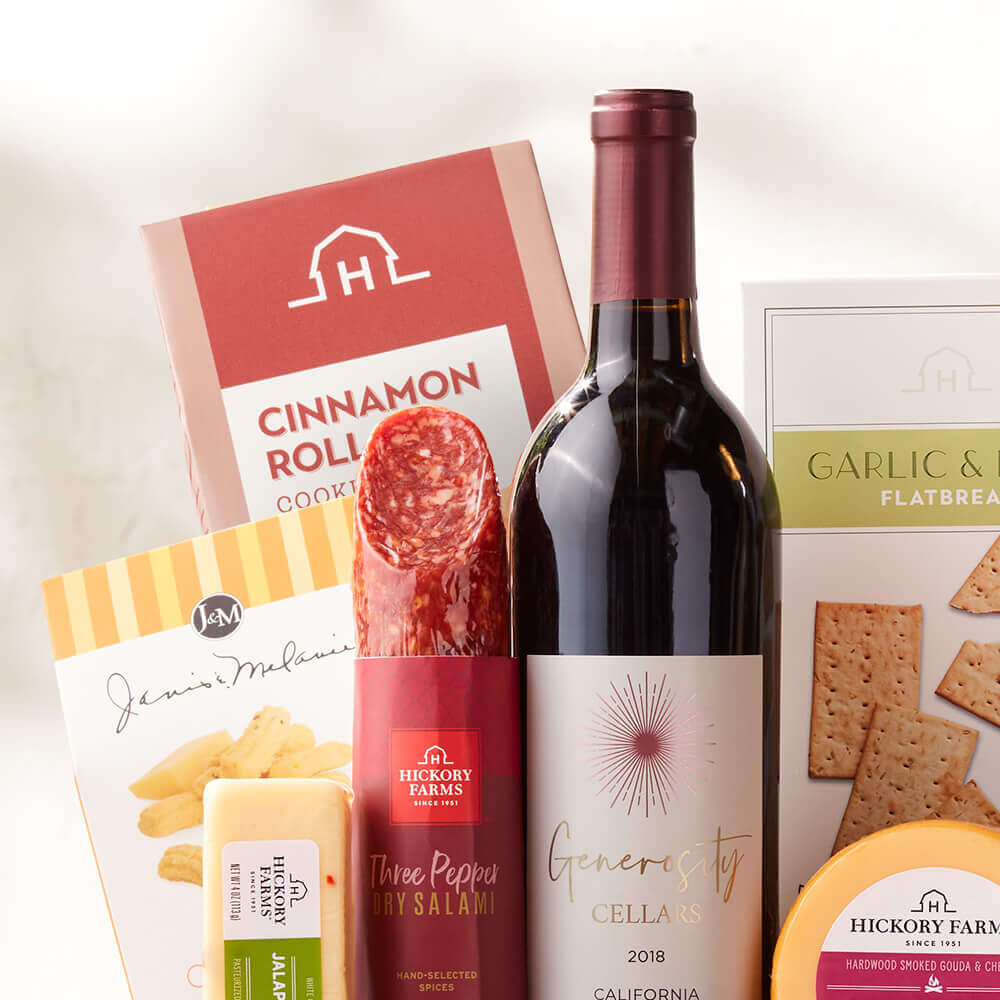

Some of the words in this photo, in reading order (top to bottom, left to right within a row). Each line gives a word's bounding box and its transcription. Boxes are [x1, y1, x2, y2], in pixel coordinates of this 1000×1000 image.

[338, 255, 375, 295] H
[937, 369, 957, 392] H
[258, 361, 481, 437] CINNAMON
[807, 449, 947, 481] GARLIC
[960, 449, 984, 478] &
[198, 603, 241, 633] J&M
[431, 754, 440, 765] H
[399, 769, 473, 782] HICKORY
[409, 783, 464, 797] FARMS
[370, 852, 426, 889] Three
[430, 849, 500, 895] Pepper
[548, 820, 753, 904] Generosity
[273, 856, 286, 926] HICKORY
[372, 891, 408, 916] DRY
[413, 891, 495, 916] SALAMI
[929, 900, 939, 913] H
[591, 903, 702, 925] CELLARS
[850, 917, 945, 935] HICKORY
[627, 949, 666, 963] 2018
[846, 958, 898, 971] HARDWOOD
[899, 959, 937, 972] SMOKED
[940, 960, 971, 972] GOUDA
[974, 960, 982, 972] &
[396, 971, 478, 980] HAND-SELECTED
[418, 983, 455, 992] SPICES
[593, 987, 700, 1000] CALIFORNIA
